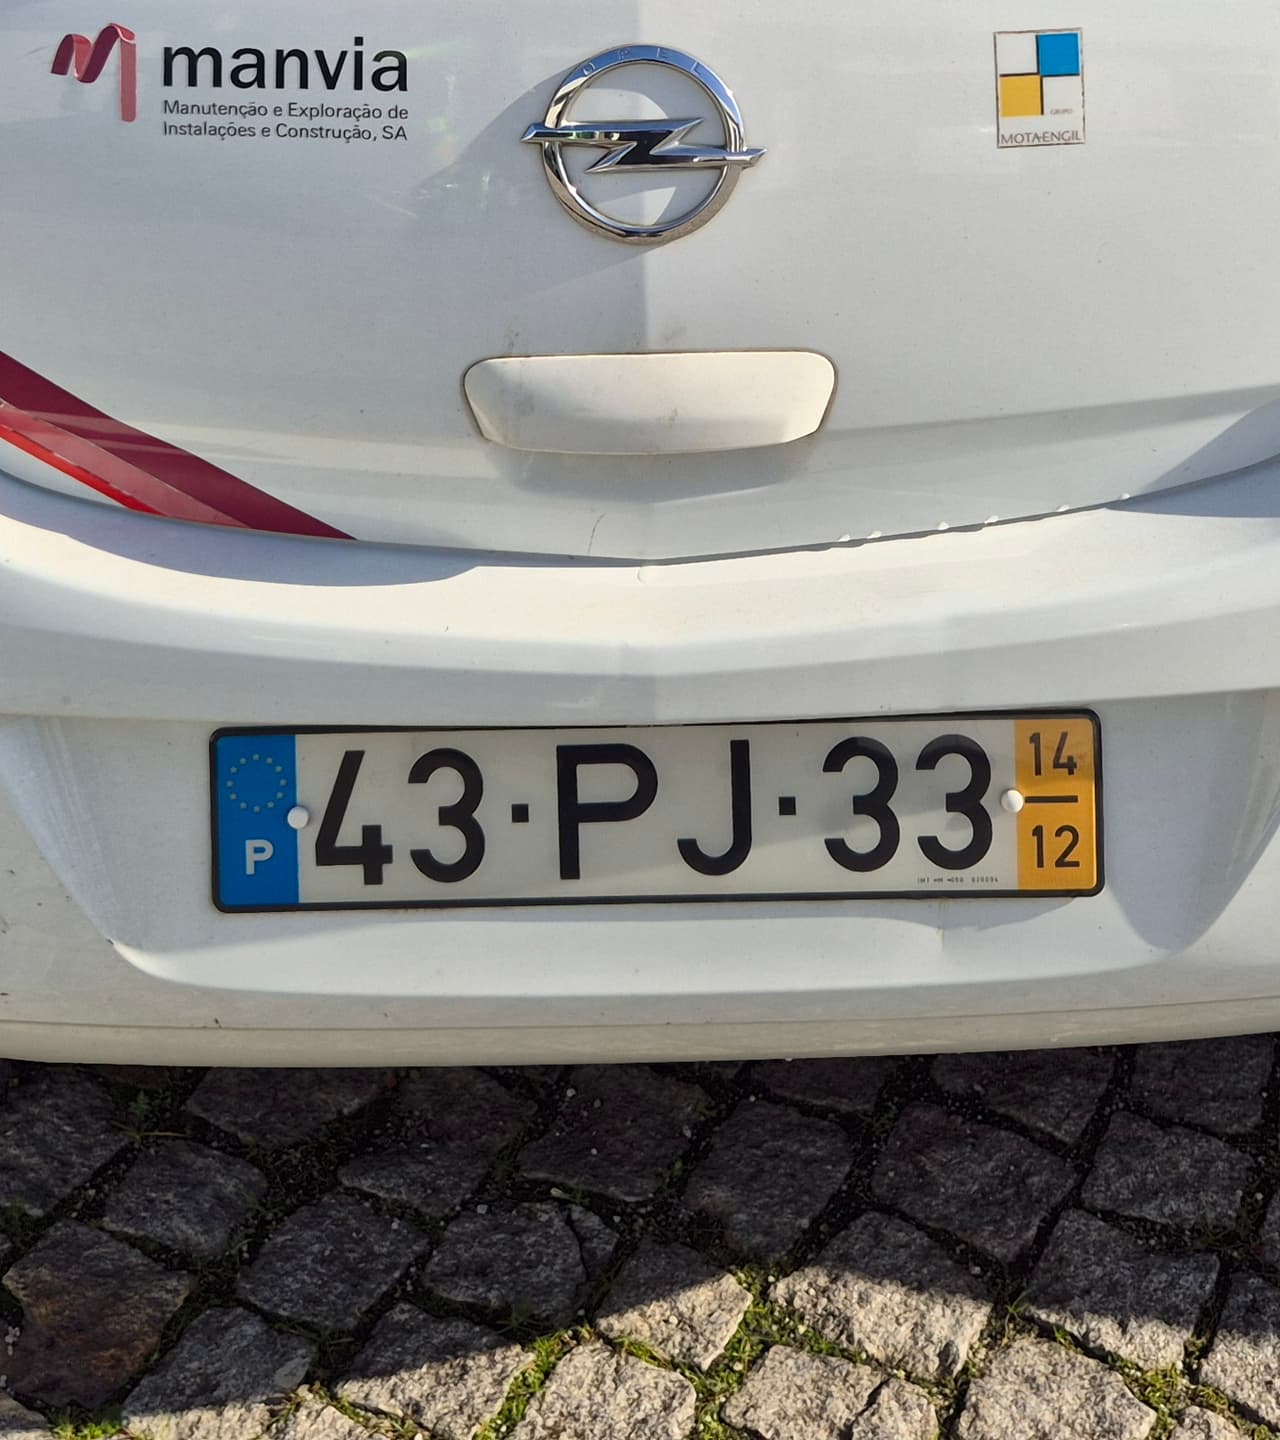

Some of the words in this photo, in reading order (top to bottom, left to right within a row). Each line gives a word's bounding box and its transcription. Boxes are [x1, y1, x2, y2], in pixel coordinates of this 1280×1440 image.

[162, 36, 409, 92] manvia
[163, 100, 268, 119] Manutenção
[273, 105, 283, 117] e
[287, 102, 383, 122] Exploração
[387, 104, 409, 120] de
[163, 121, 256, 141] Instalações
[261, 125, 271, 137] e
[275, 122, 377, 144] Construção,
[381, 125, 408, 141] SA
[1029, 731, 1078, 776] 14
[245, 839, 274, 875] P
[1031, 824, 1080, 869] 12
